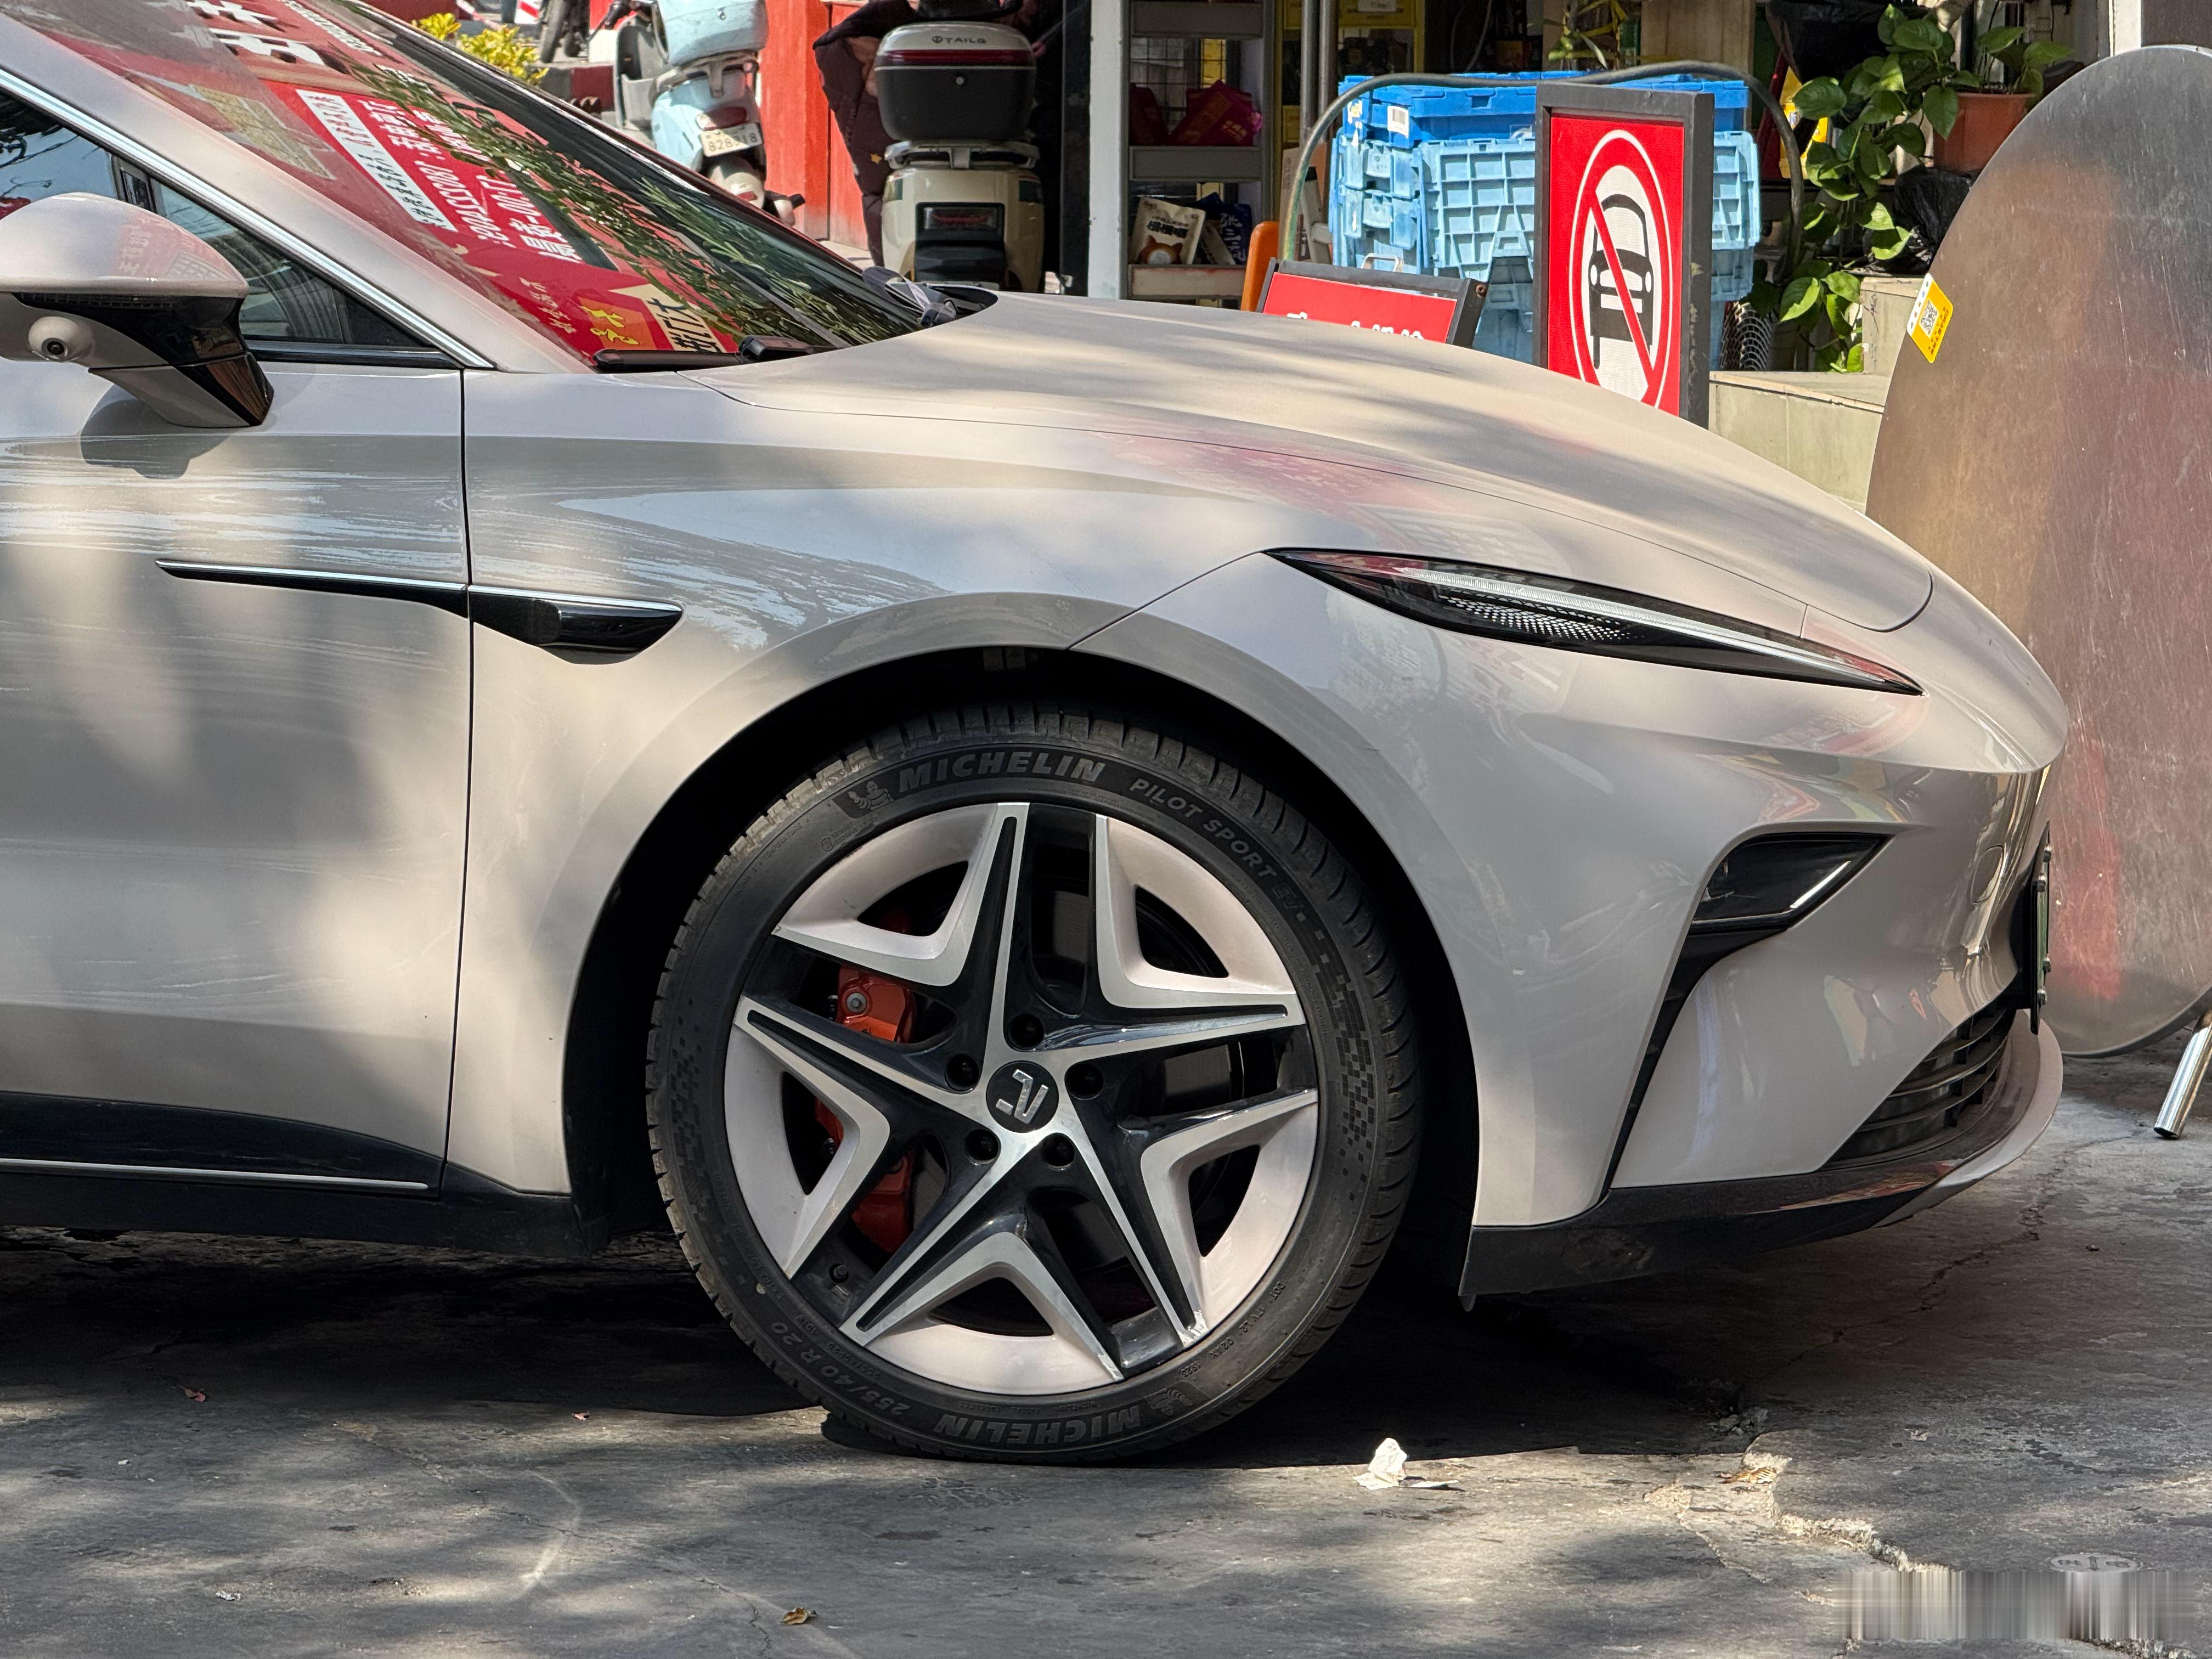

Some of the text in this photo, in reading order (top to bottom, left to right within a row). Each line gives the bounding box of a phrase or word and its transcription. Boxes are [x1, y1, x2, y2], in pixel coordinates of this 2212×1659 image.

[899, 752, 1106, 793] MICHELIN
[1130, 778, 1203, 817] PILOT
[1203, 819, 1278, 878] SPORT
[1272, 882, 1305, 910] EV
[1268, 1282, 1286, 1300] DOT
[770, 1322, 911, 1415] 255/40 R 20
[934, 1405, 1140, 1445] MICHELIN
